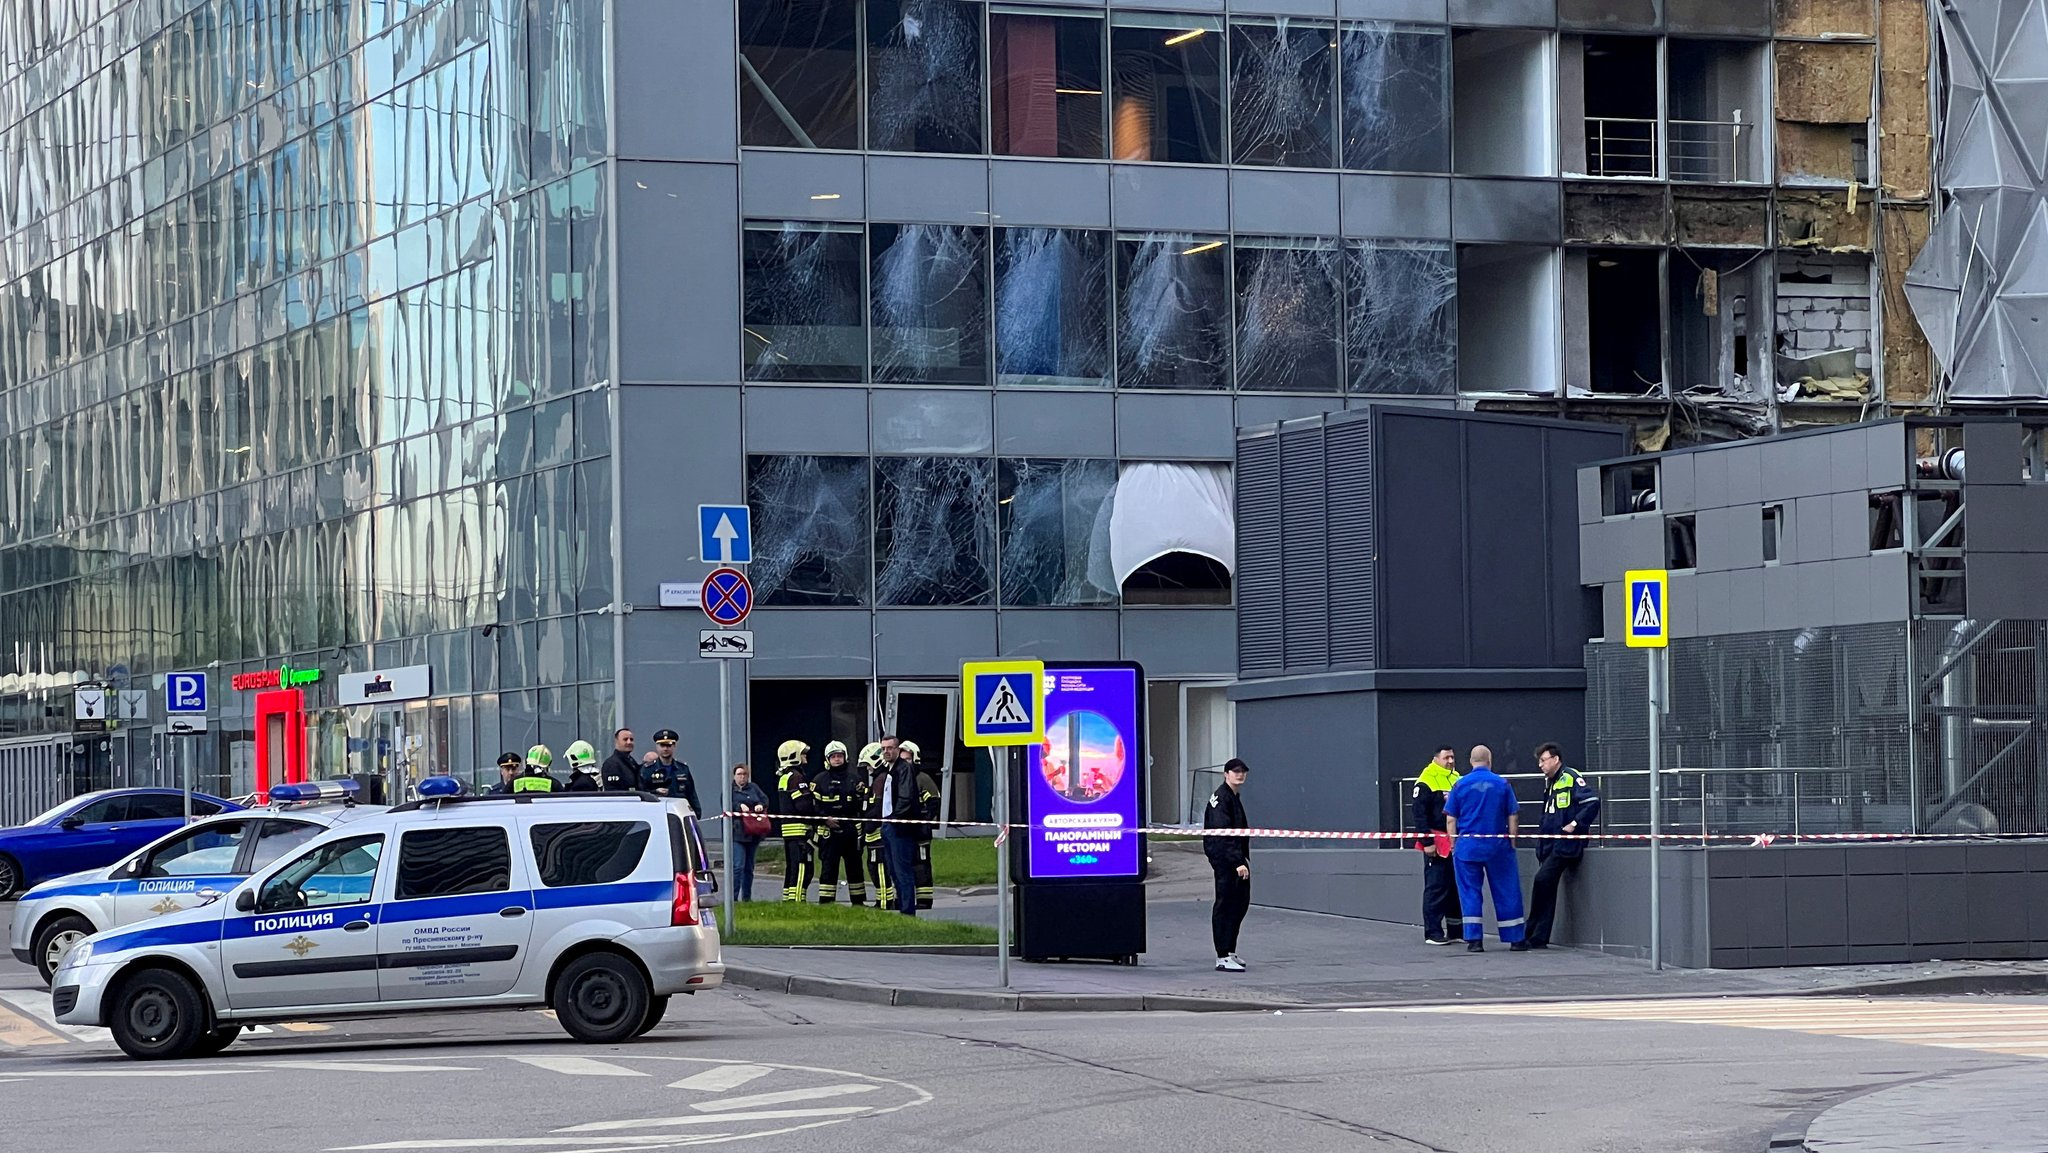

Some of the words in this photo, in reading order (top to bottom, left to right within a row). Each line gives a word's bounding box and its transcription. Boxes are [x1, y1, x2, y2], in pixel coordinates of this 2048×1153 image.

[232, 669, 280, 690] EUROSPAR
[175, 676, 198, 707] P
[1057, 843, 1110, 853] РЕСТОРАН
[138, 880, 196, 893] ПОЛИЦИЯ
[254, 912, 334, 932] ПОЛИЦИЯ
[414, 927, 440, 935] ОМВД
[413, 936, 466, 944] Пресненскому
[467, 934, 483, 942] р-ну
